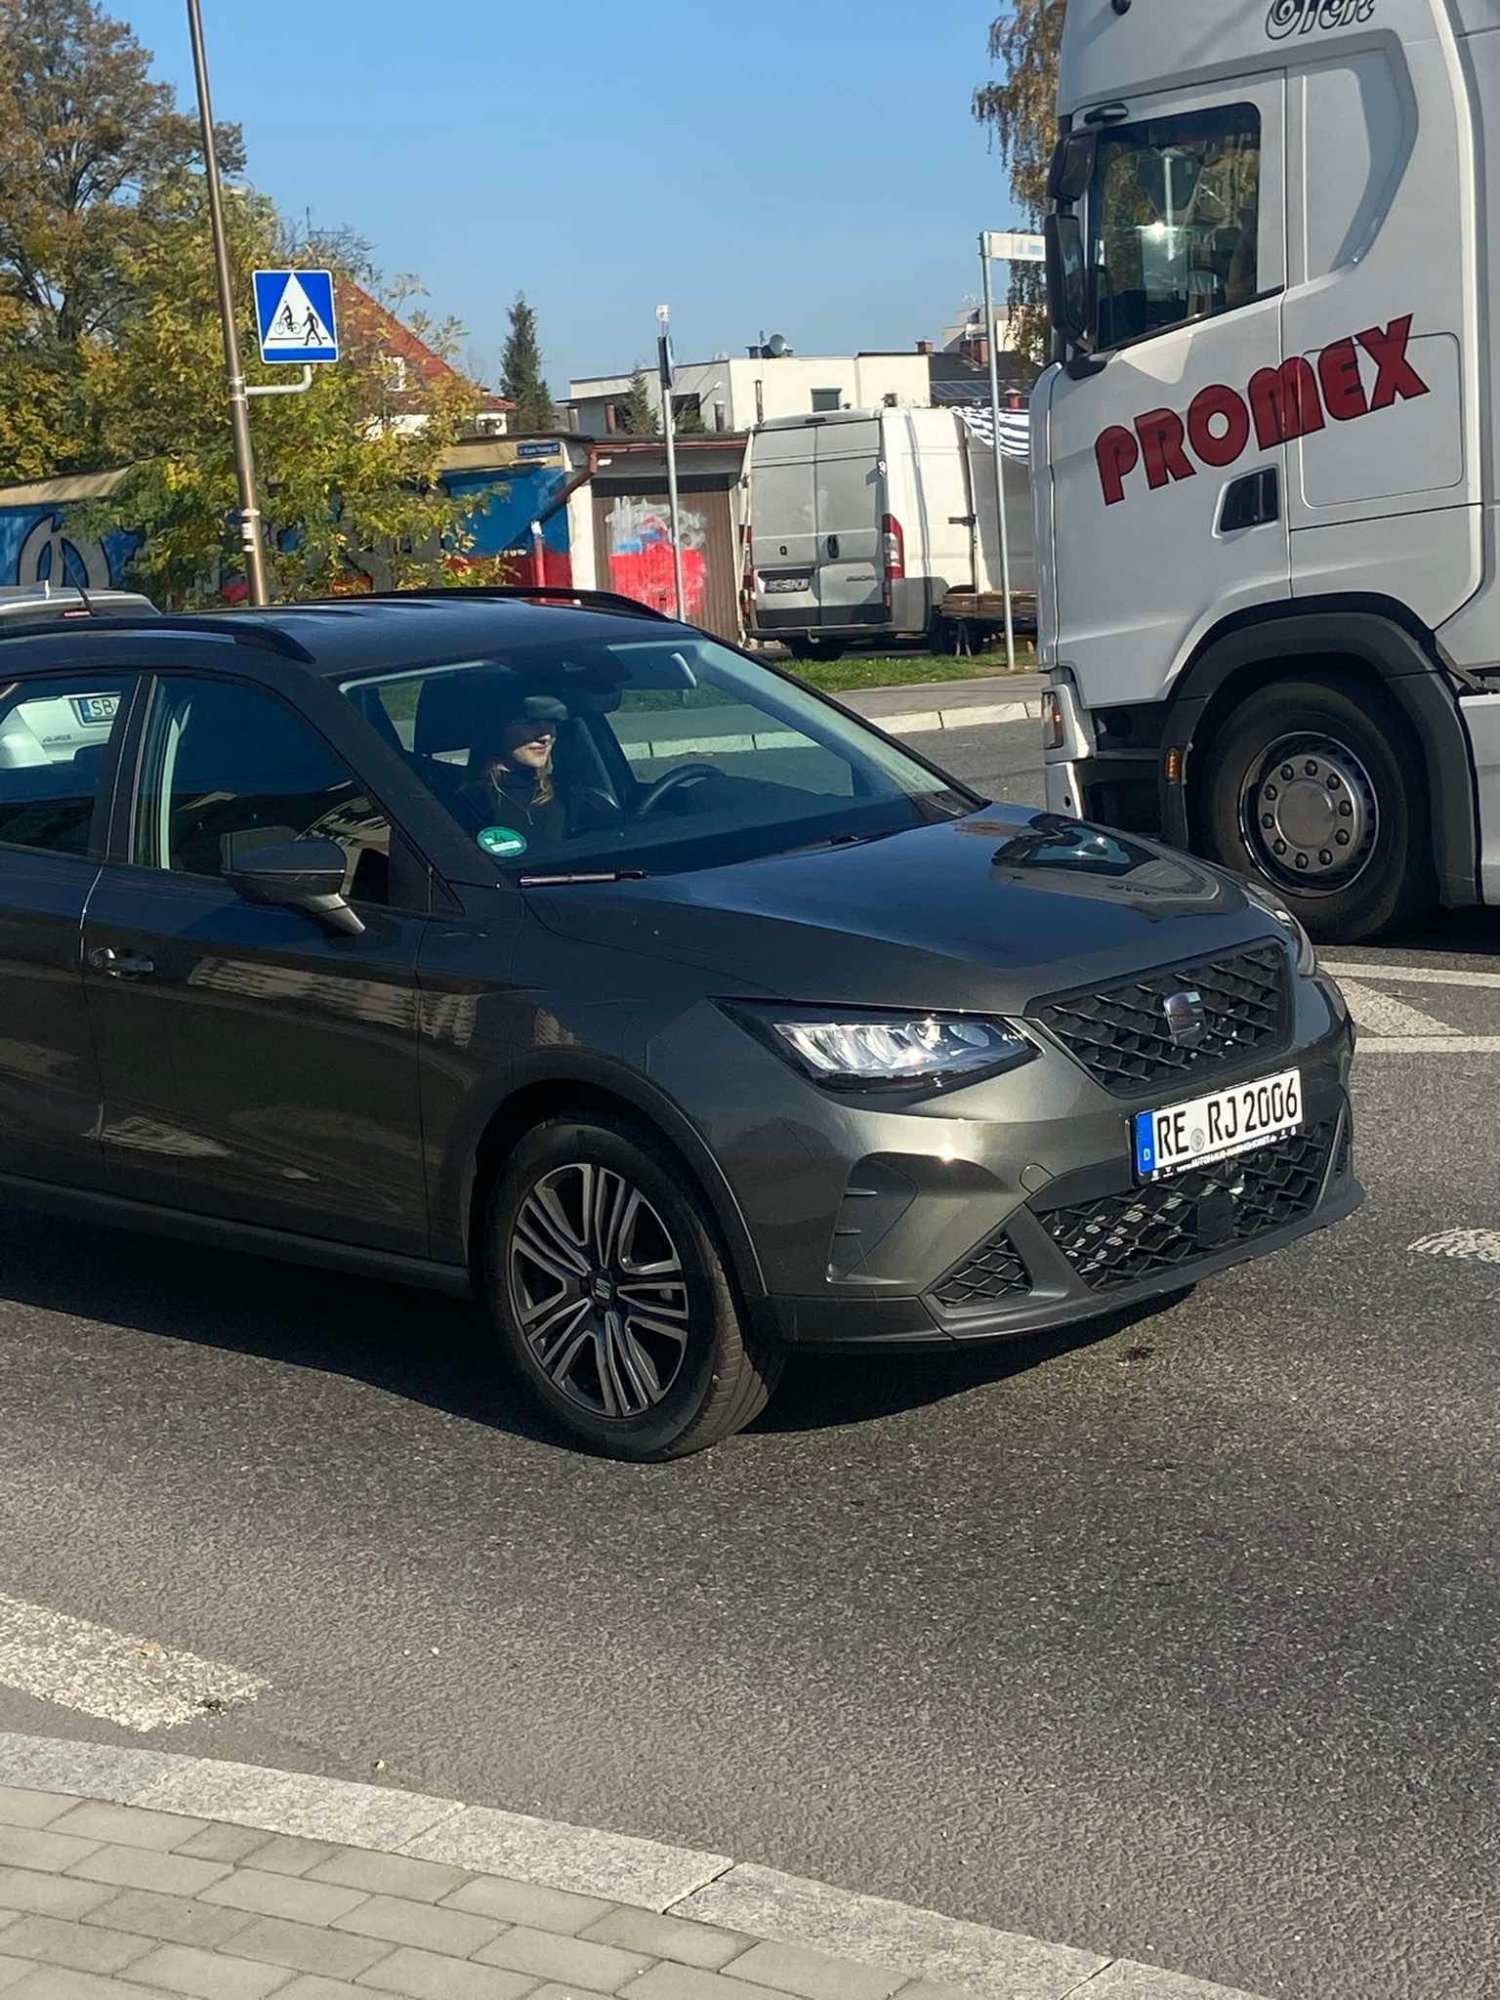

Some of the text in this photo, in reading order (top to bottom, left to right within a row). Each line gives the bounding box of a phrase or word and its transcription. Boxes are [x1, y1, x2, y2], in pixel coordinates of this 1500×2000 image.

[1093, 312, 1431, 507] PROMEX
[1156, 1110, 1189, 1160] RE
[1207, 1095, 1239, 1145] RJ
[1243, 1077, 1298, 1133] 2006
